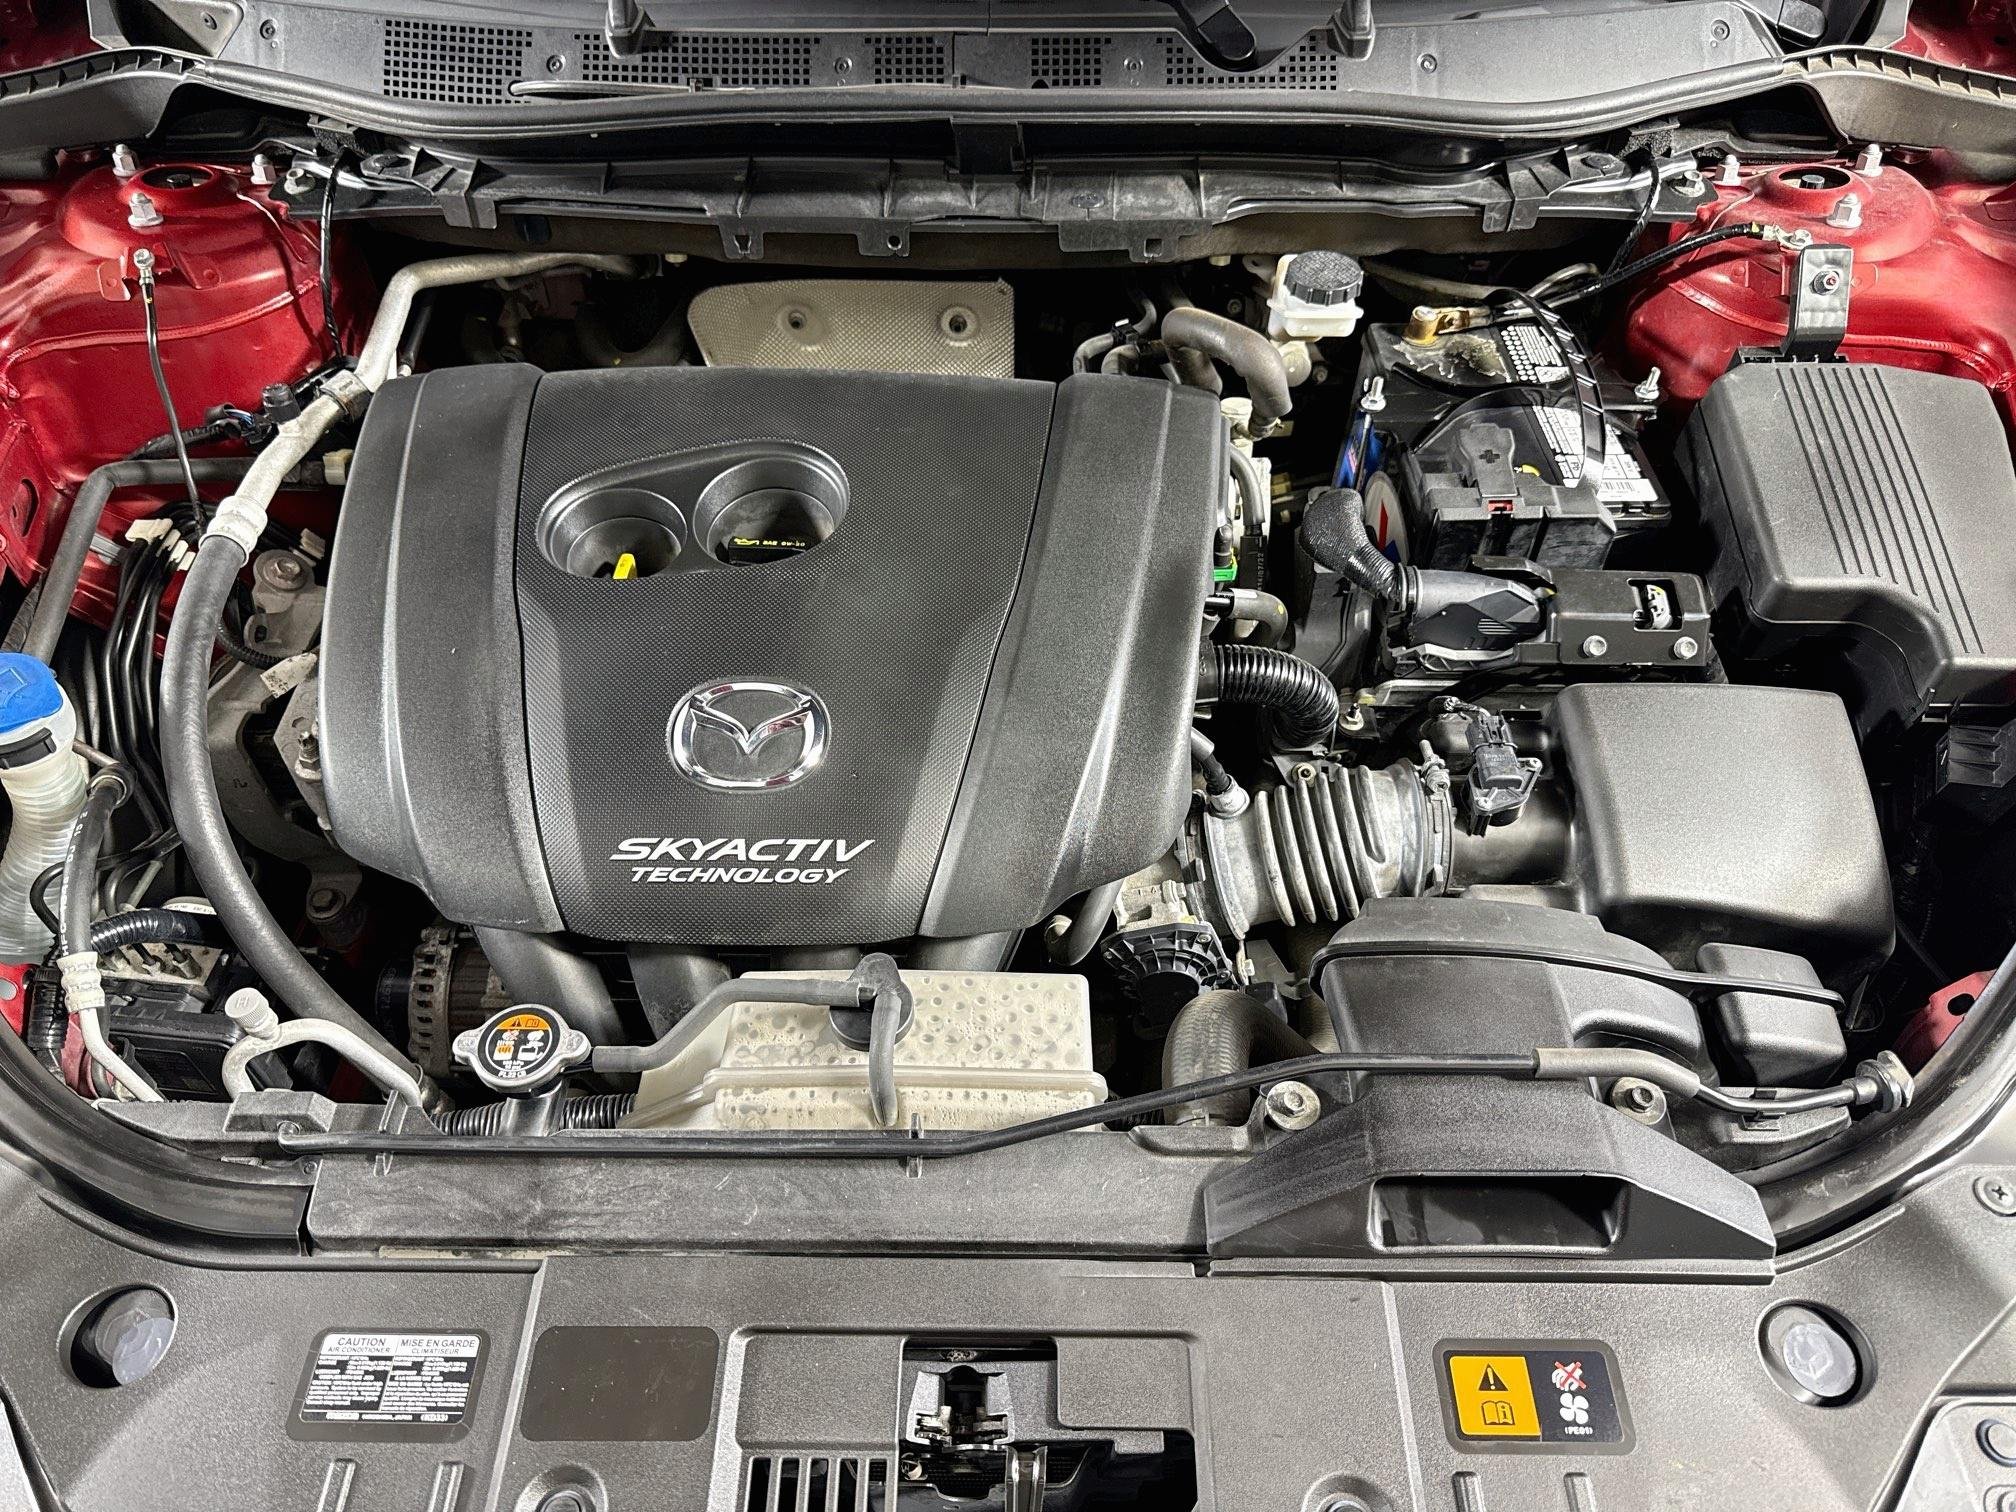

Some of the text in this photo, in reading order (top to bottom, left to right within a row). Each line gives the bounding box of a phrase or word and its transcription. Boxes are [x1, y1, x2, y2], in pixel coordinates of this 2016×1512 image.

[610, 837, 875, 862] SKYACTIV
[630, 867, 850, 884] TECHNOLOGY
[338, 1337, 386, 1347] CAUTION
[400, 1339, 476, 1348] MISE EN GARDE
